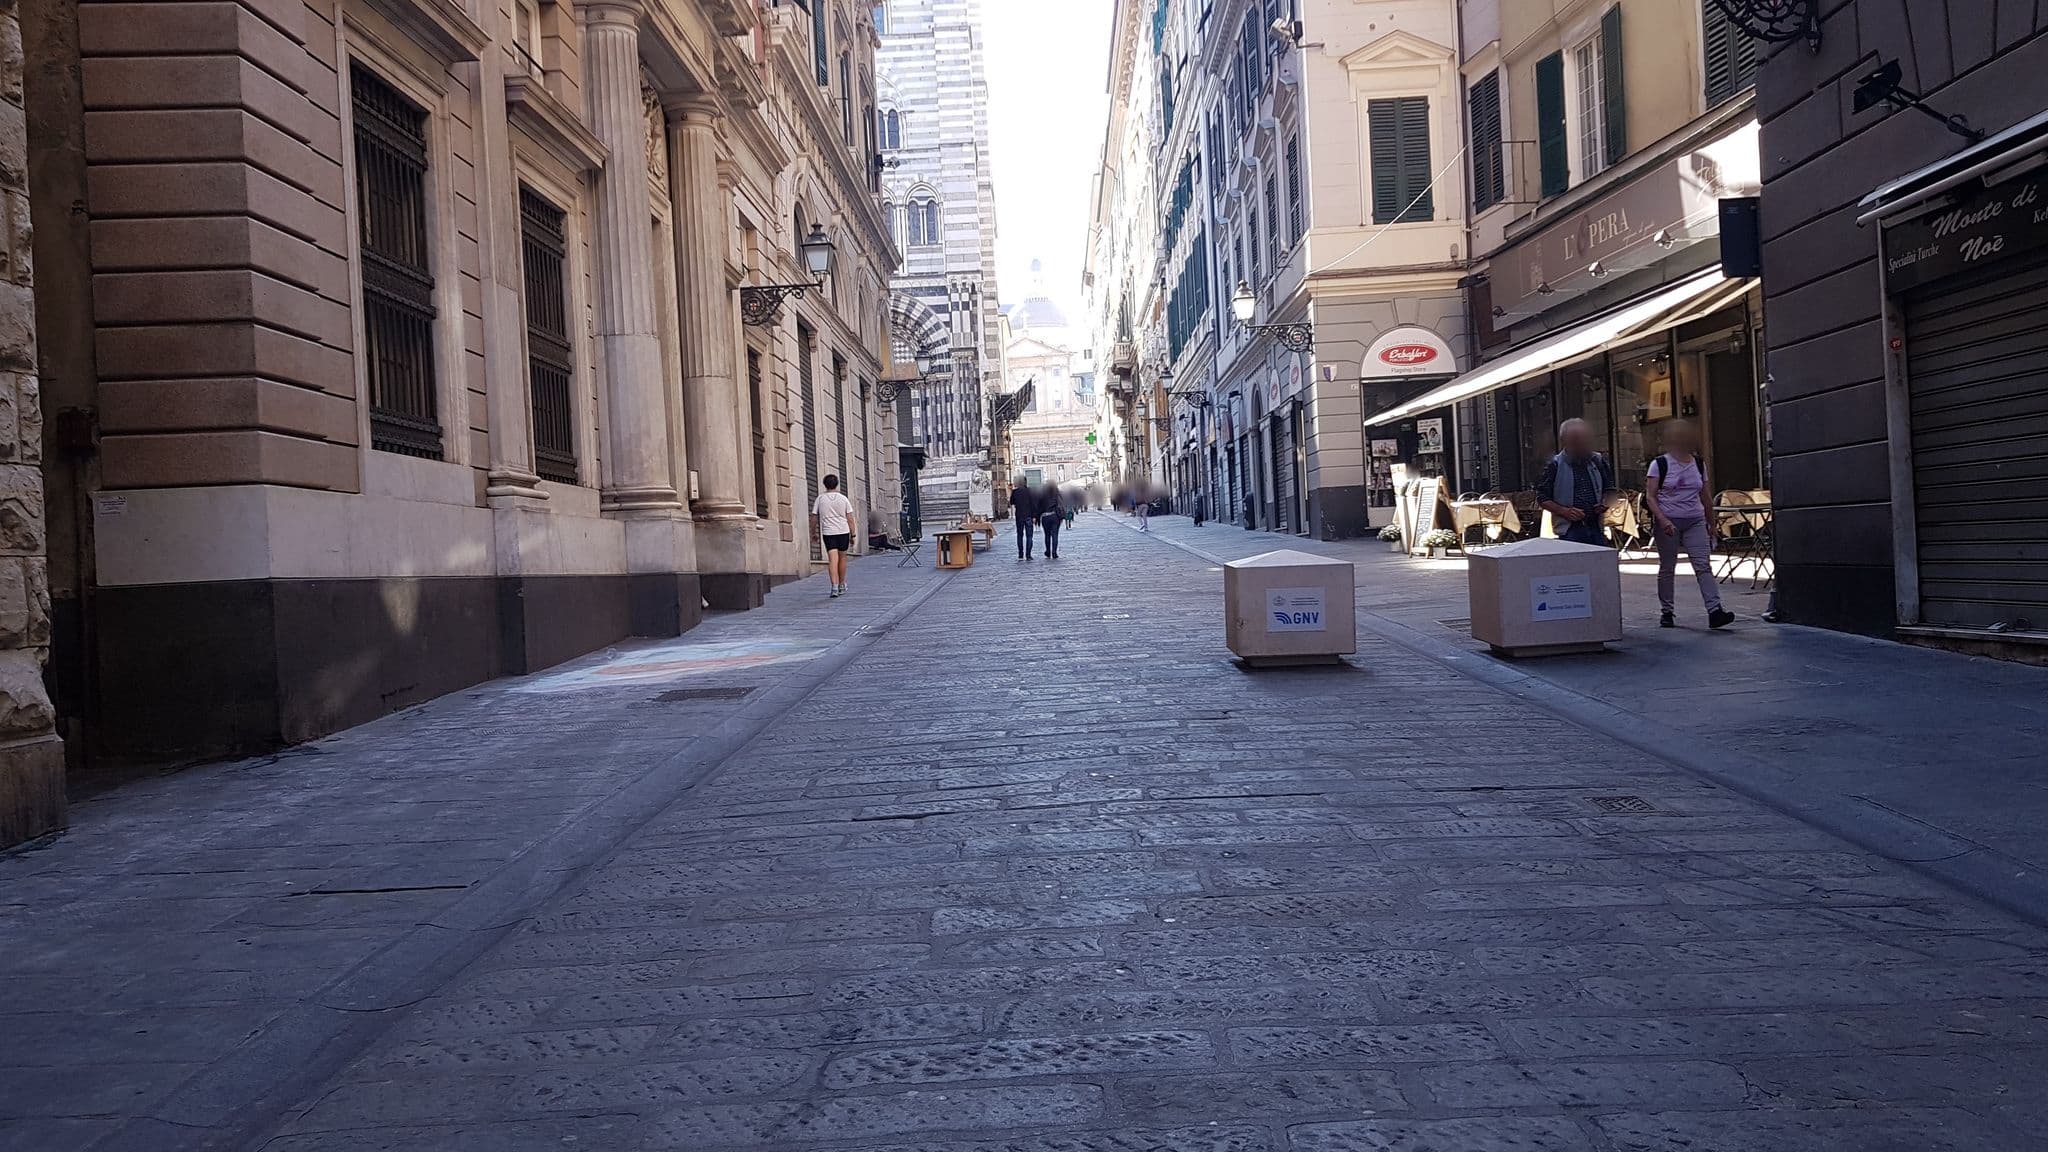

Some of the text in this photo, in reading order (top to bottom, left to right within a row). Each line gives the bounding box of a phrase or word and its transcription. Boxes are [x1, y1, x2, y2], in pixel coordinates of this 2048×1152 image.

[1931, 184, 2037, 238] Monte di
[1293, 612, 1319, 625] GNV
